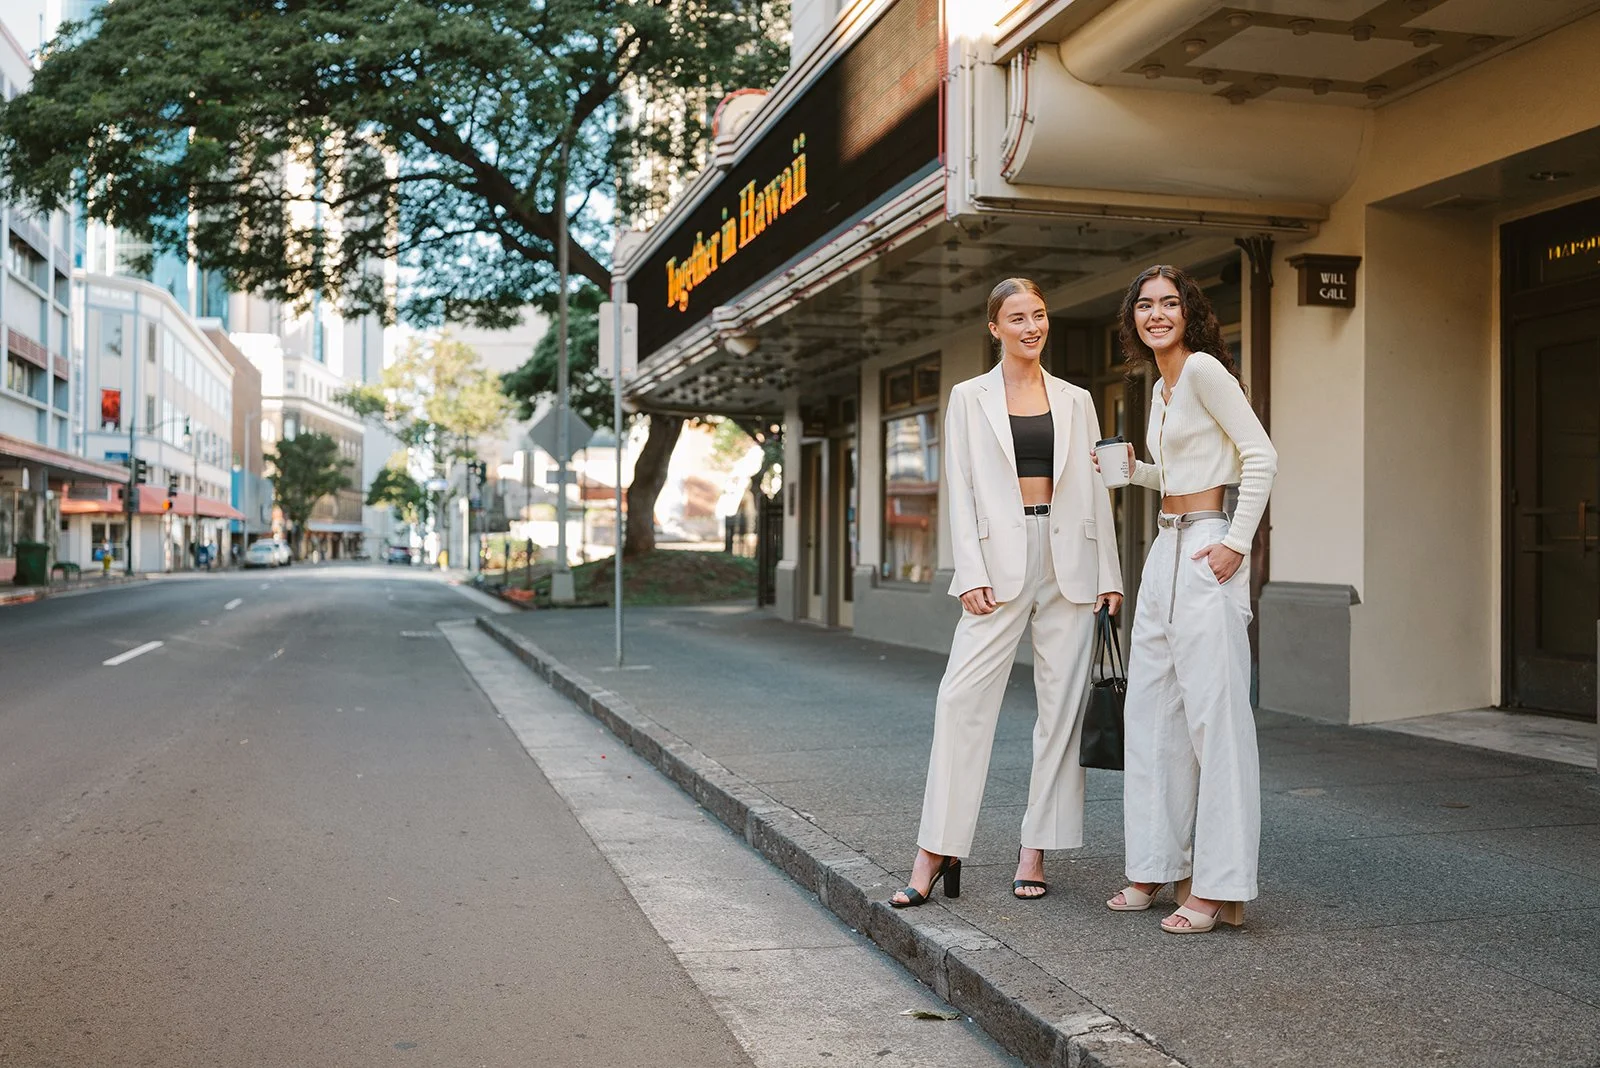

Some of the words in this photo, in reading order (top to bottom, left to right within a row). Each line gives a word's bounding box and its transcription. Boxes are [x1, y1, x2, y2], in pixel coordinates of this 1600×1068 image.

[666, 231, 720, 312] Together
[721, 207, 737, 263] in
[738, 133, 807, 248] Hawaii
[1320, 272, 1347, 285] WILL
[1319, 288, 1347, 300] CALL
